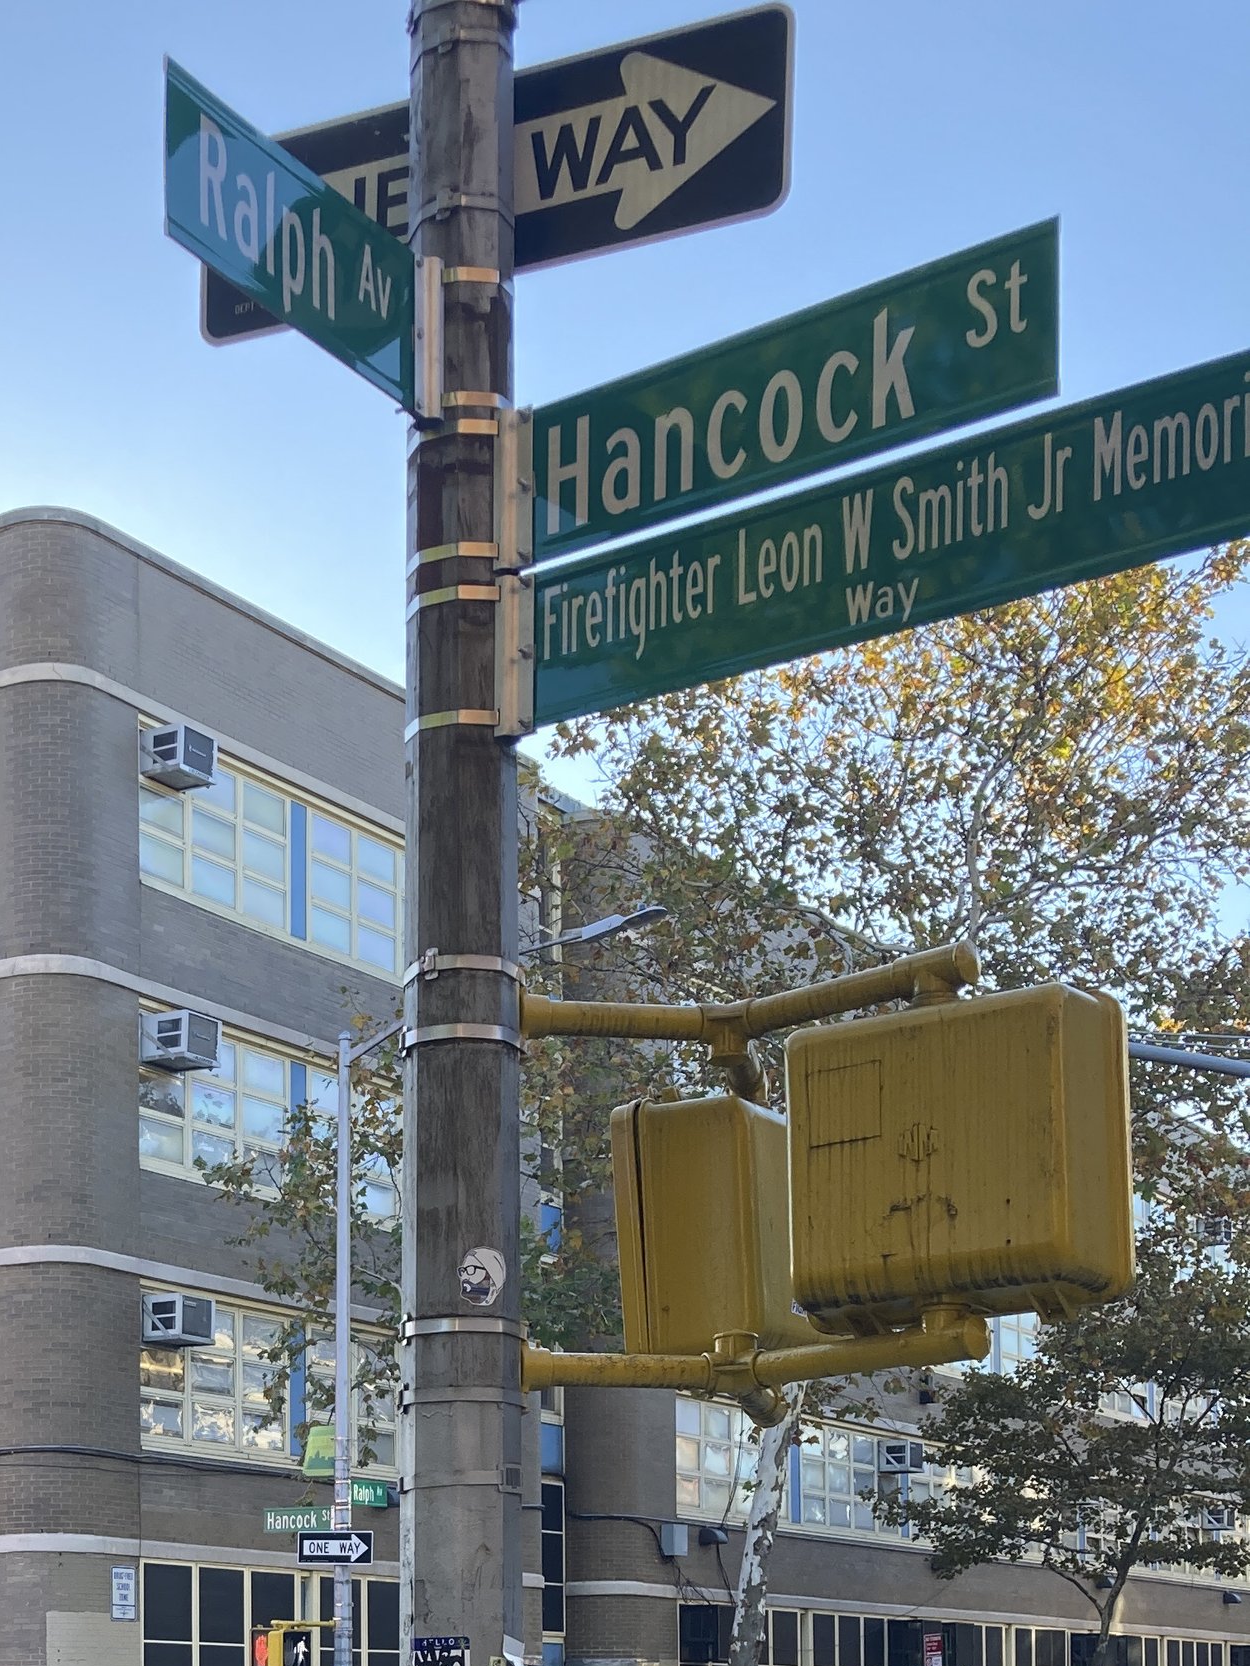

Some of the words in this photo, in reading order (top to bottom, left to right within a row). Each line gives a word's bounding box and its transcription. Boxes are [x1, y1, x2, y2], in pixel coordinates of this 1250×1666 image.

[531, 83, 717, 201] WAY
[200, 112, 336, 321] Ralph
[358, 244, 392, 320] Av
[547, 307, 916, 535] Hancock
[965, 259, 1028, 348] St
[543, 550, 721, 661] Firefighter
[738, 523, 823, 605] Leon
[842, 488, 874, 574] W
[892, 451, 1009, 560] Smith
[1027, 432, 1072, 520] Jr
[846, 577, 919, 626] Way
[267, 1511, 317, 1530] Hancock
[322, 1509, 330, 1521] St
[353, 1484, 374, 1504] Ralph
[309, 1542, 329, 1554] ONE
[339, 1542, 361, 1554] WAY
